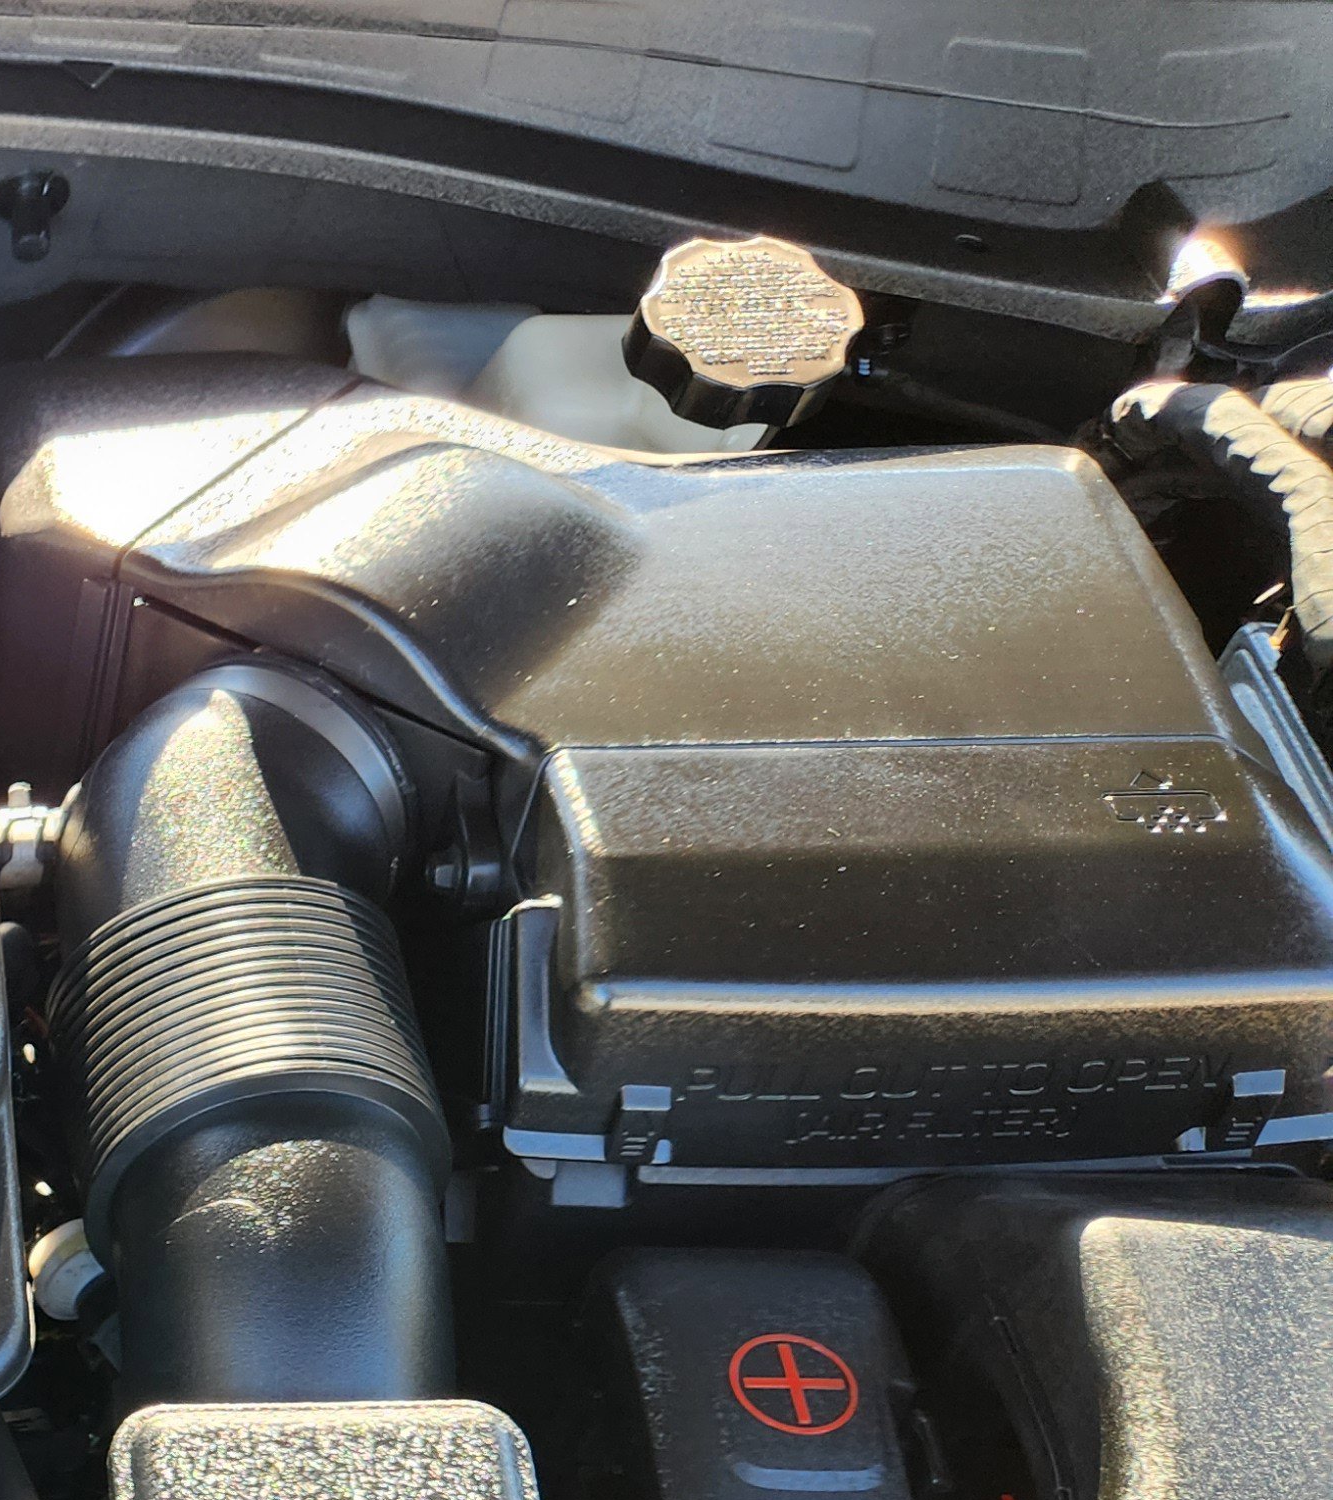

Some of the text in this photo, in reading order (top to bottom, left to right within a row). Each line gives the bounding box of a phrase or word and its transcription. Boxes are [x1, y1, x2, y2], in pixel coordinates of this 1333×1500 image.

[677, 1057, 1231, 1101] PULL OUT TO OPEN
